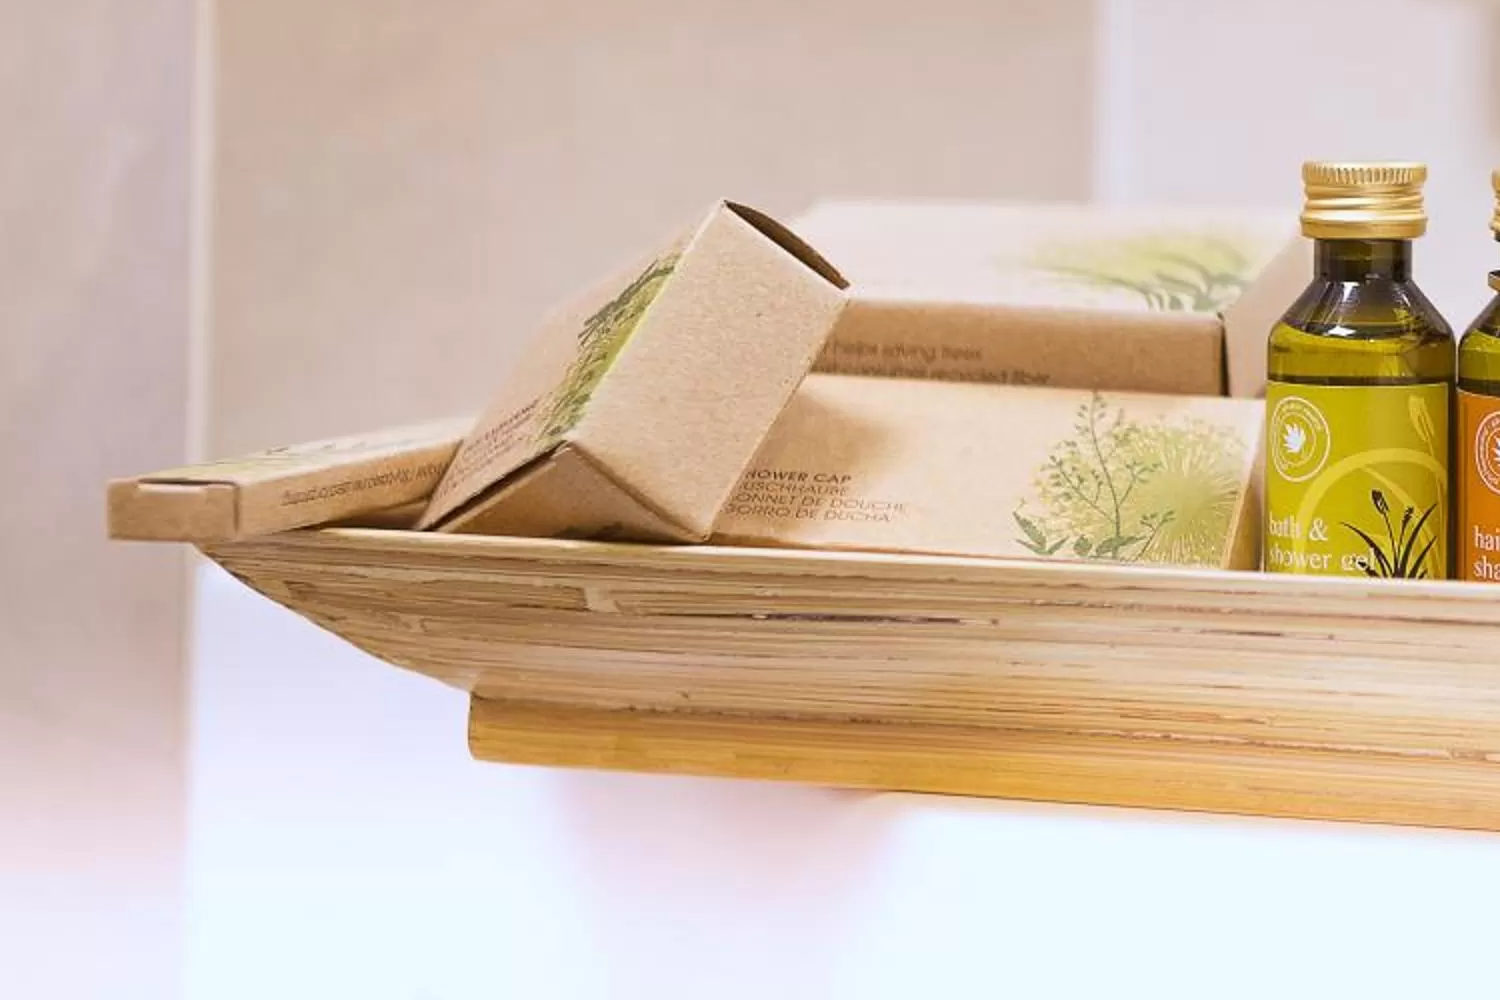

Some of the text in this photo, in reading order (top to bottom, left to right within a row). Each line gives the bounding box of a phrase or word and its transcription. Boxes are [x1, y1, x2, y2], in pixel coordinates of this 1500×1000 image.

[743, 468, 853, 486] HOWER CAP
[1268, 511, 1329, 541] bath &
[1268, 543, 1376, 574] shower gel
